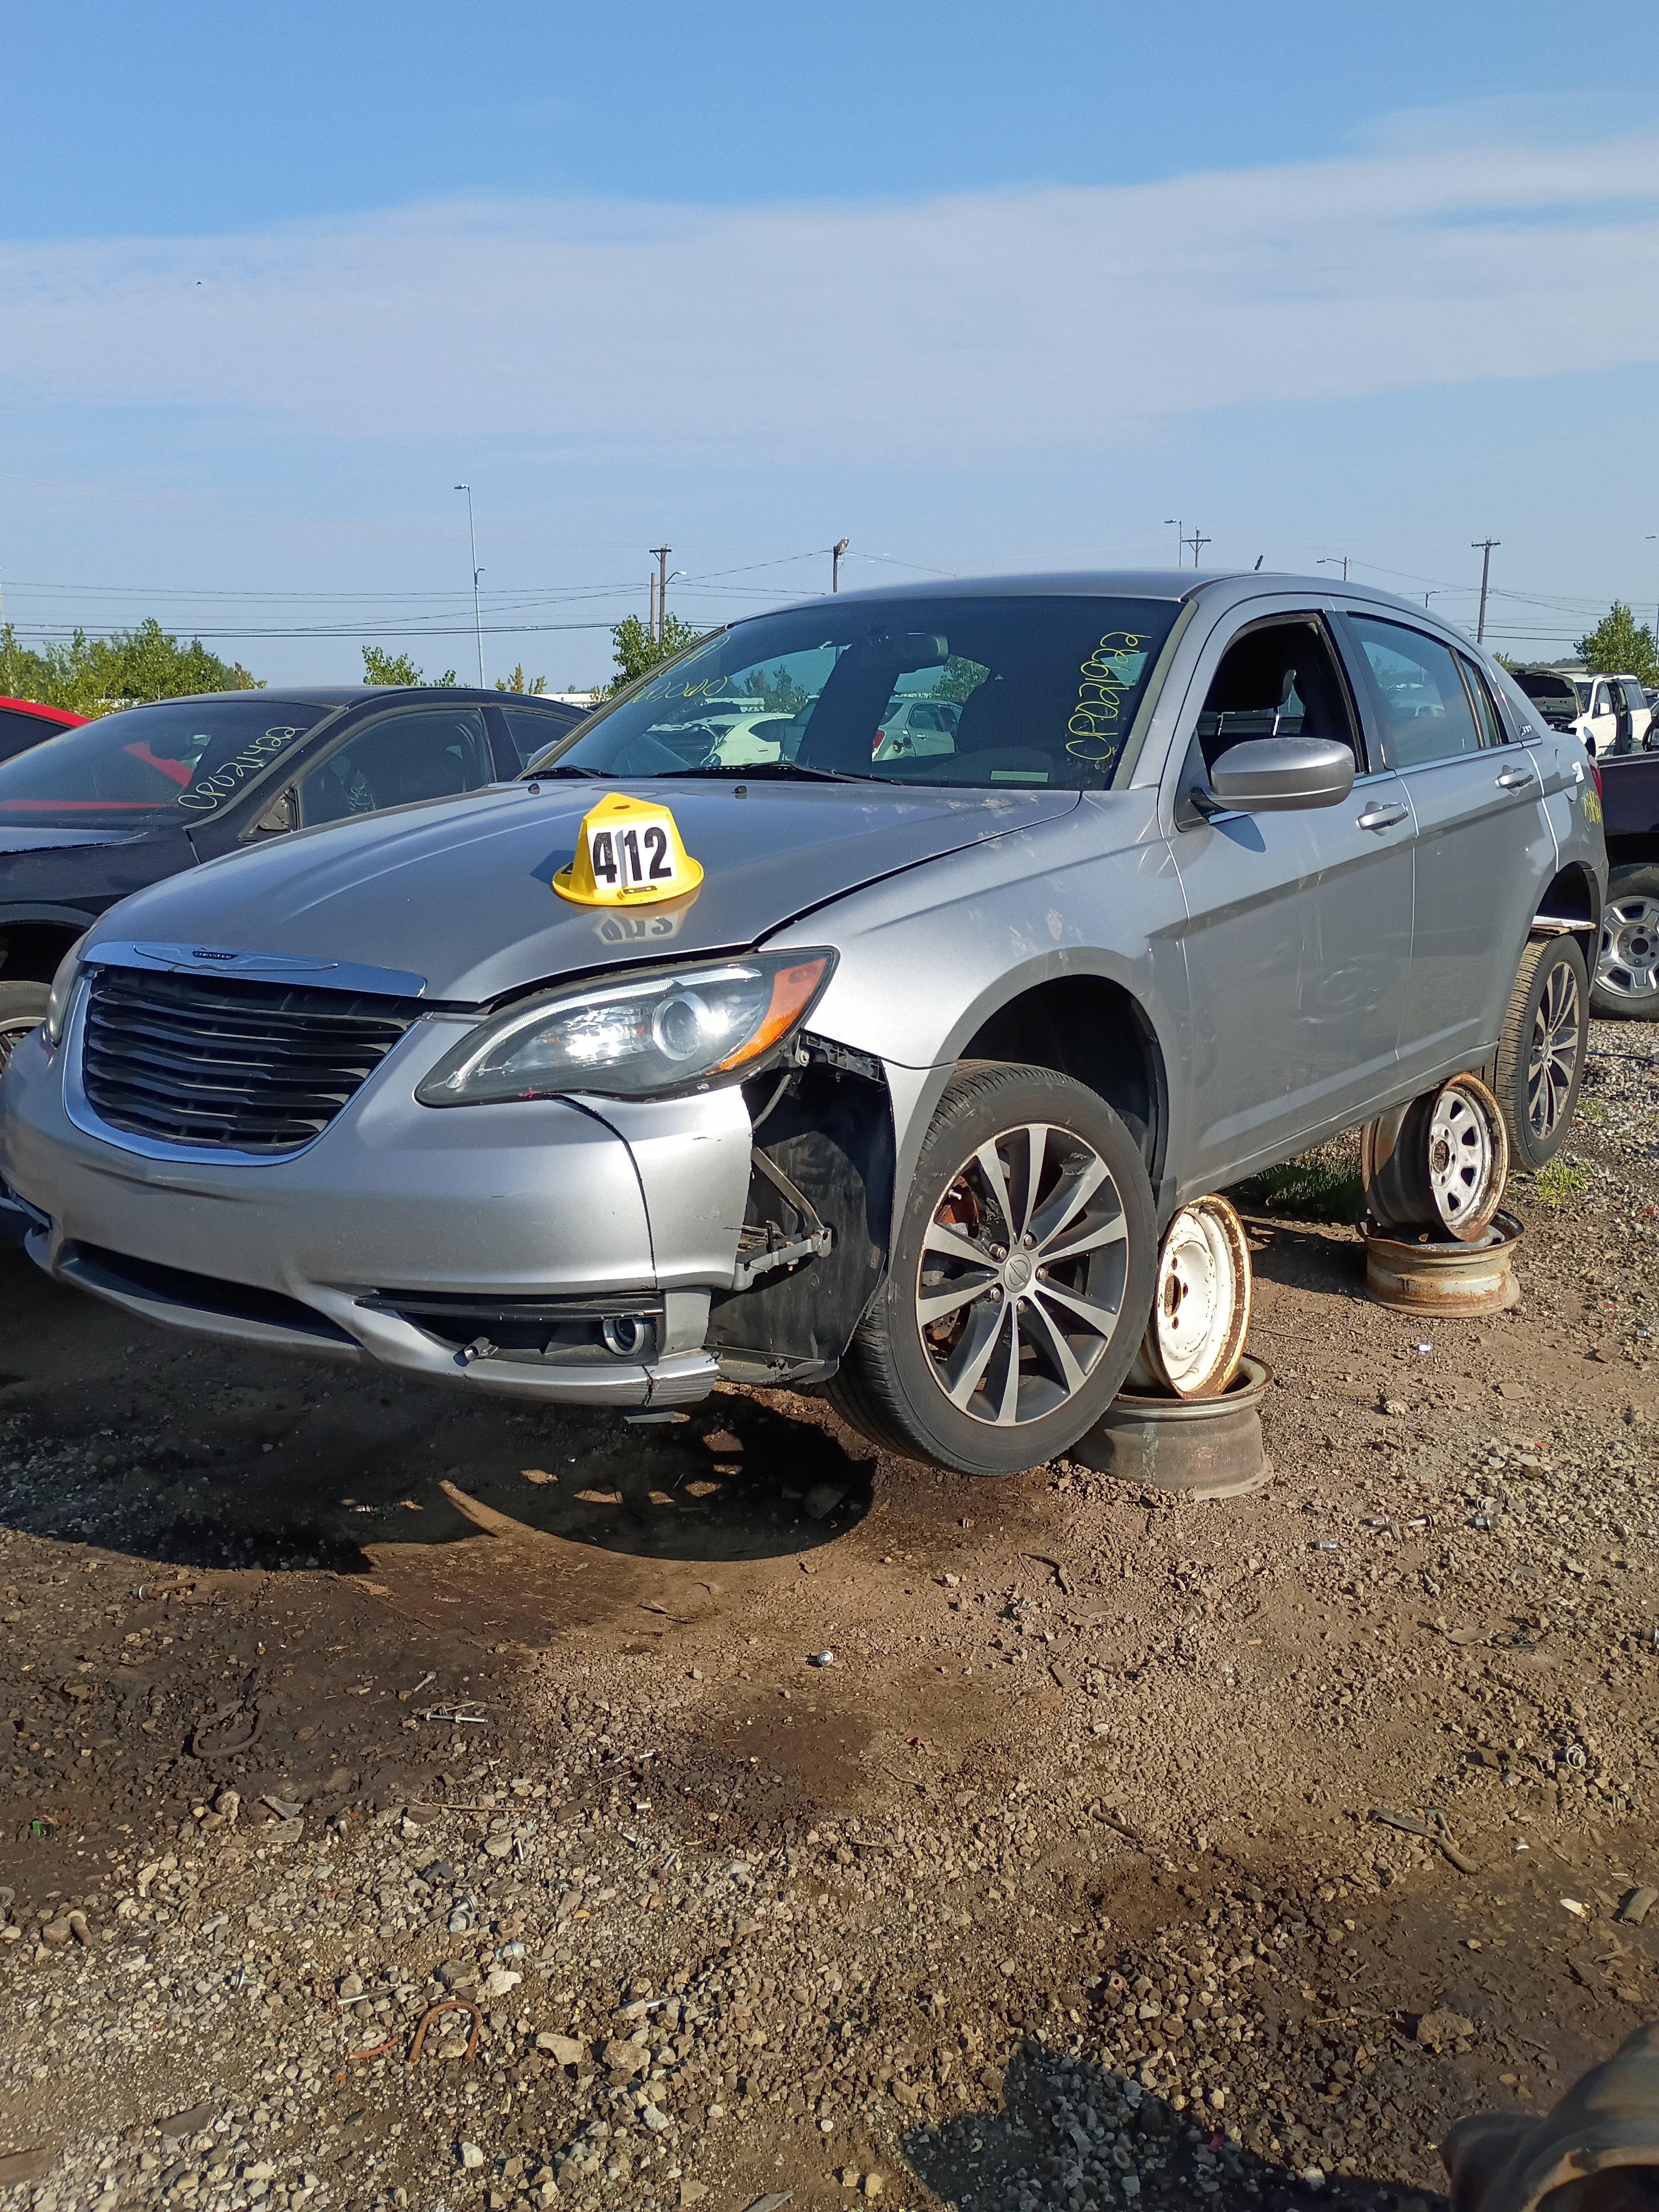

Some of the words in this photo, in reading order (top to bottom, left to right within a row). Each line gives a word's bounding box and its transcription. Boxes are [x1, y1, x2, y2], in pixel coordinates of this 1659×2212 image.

[1065, 631, 1152, 760] CP021922
[178, 726, 308, 809] CP021422
[592, 826, 672, 884] 412
